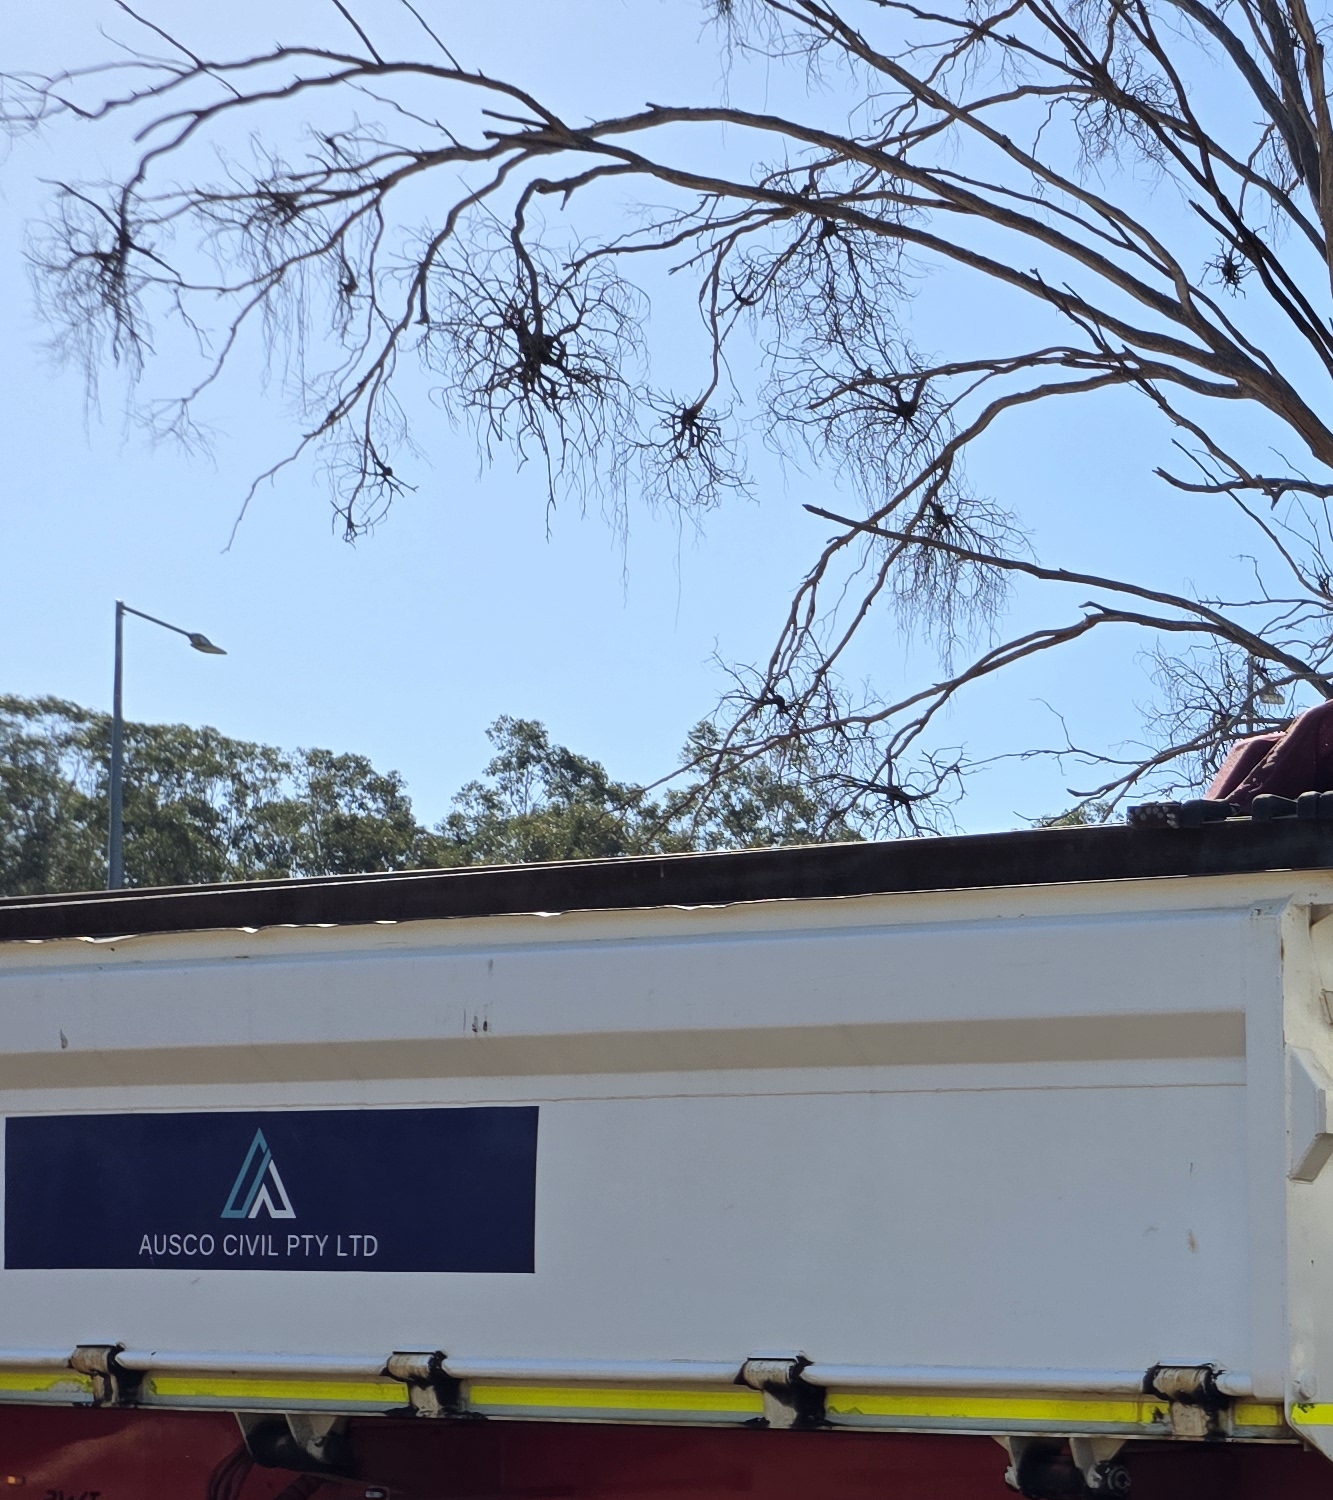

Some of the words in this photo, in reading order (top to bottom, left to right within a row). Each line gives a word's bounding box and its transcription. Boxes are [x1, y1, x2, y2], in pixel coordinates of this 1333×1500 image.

[139, 1234, 215, 1256] AUSCO
[223, 1234, 279, 1256] CIVIL
[287, 1234, 329, 1256] PTY
[336, 1234, 379, 1257] LTD
